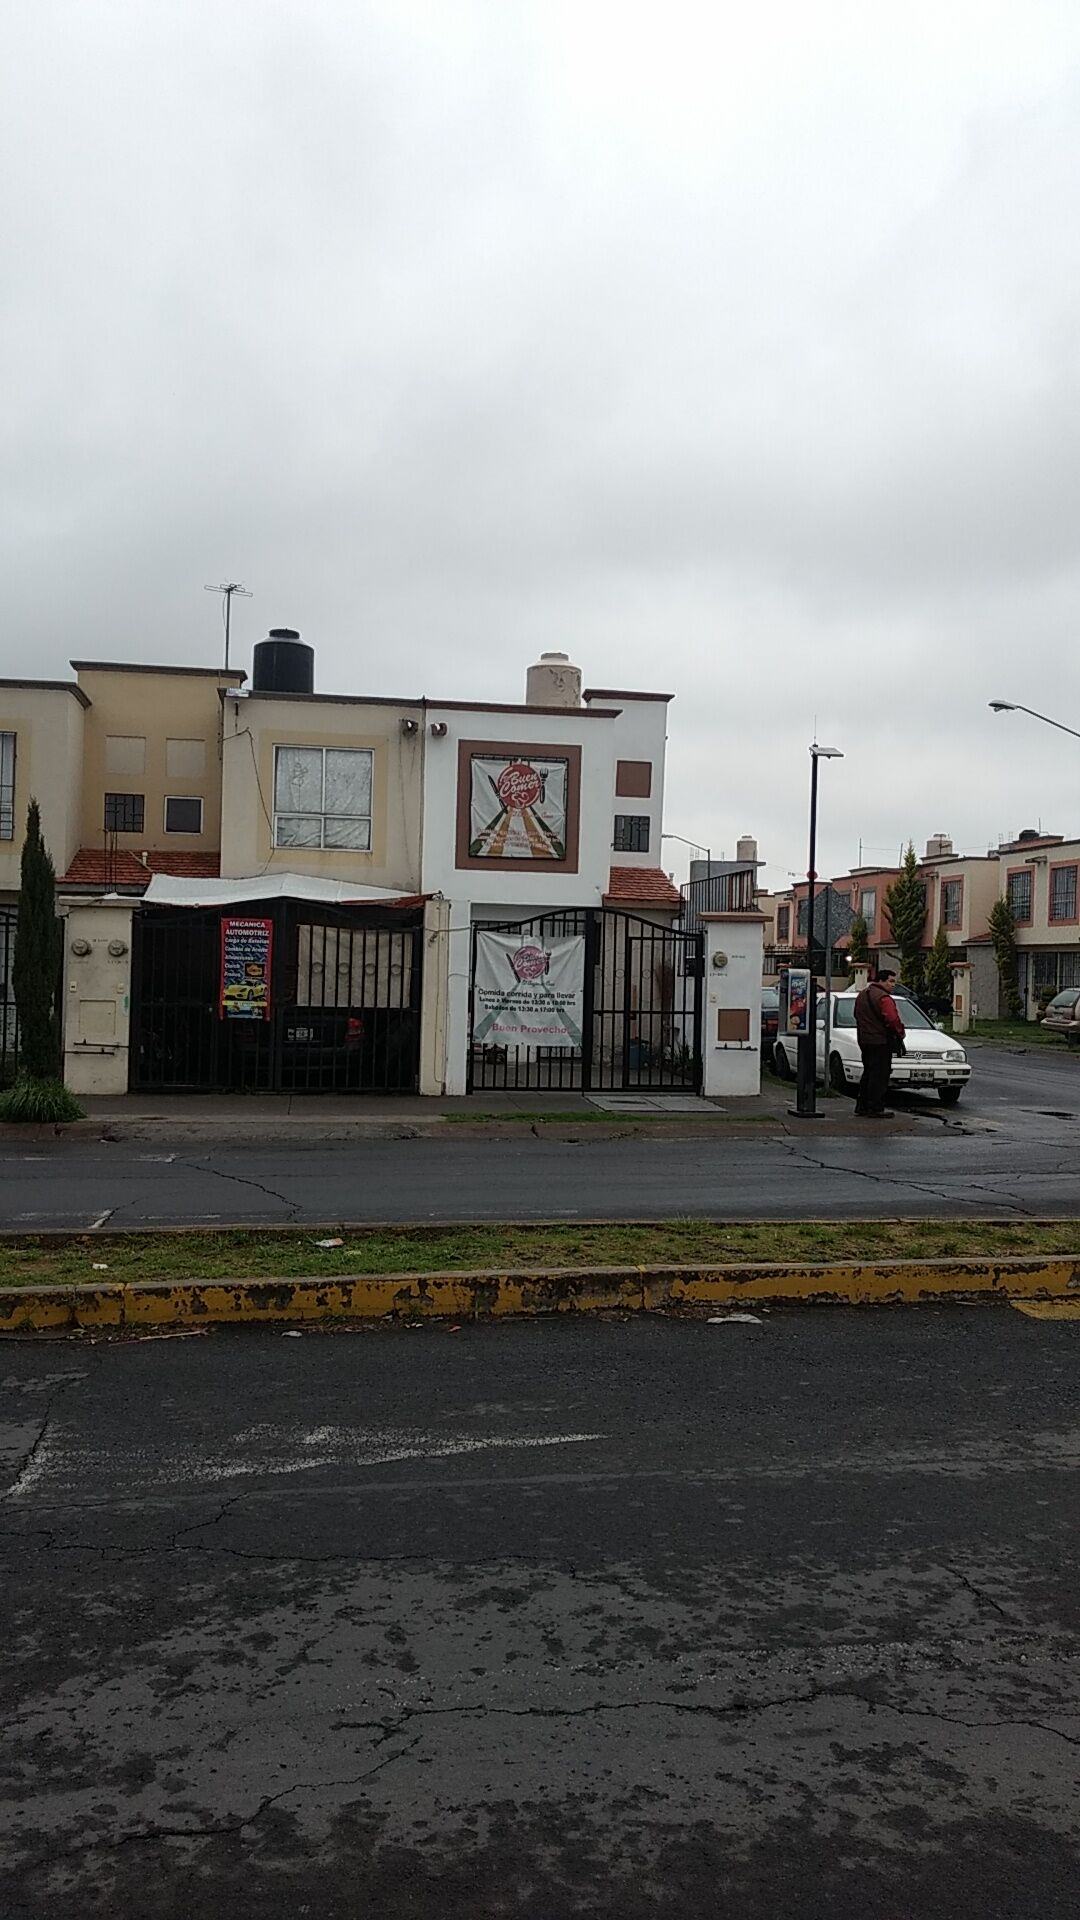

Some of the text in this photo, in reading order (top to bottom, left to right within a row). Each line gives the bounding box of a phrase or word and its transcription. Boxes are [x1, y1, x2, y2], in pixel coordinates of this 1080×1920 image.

[510, 772, 538, 785] Buen
[500, 779, 540, 797] Comer
[225, 929, 270, 937] AUTOMOTRIZ
[478, 988, 505, 997] Comida
[507, 990, 532, 998] corrida
